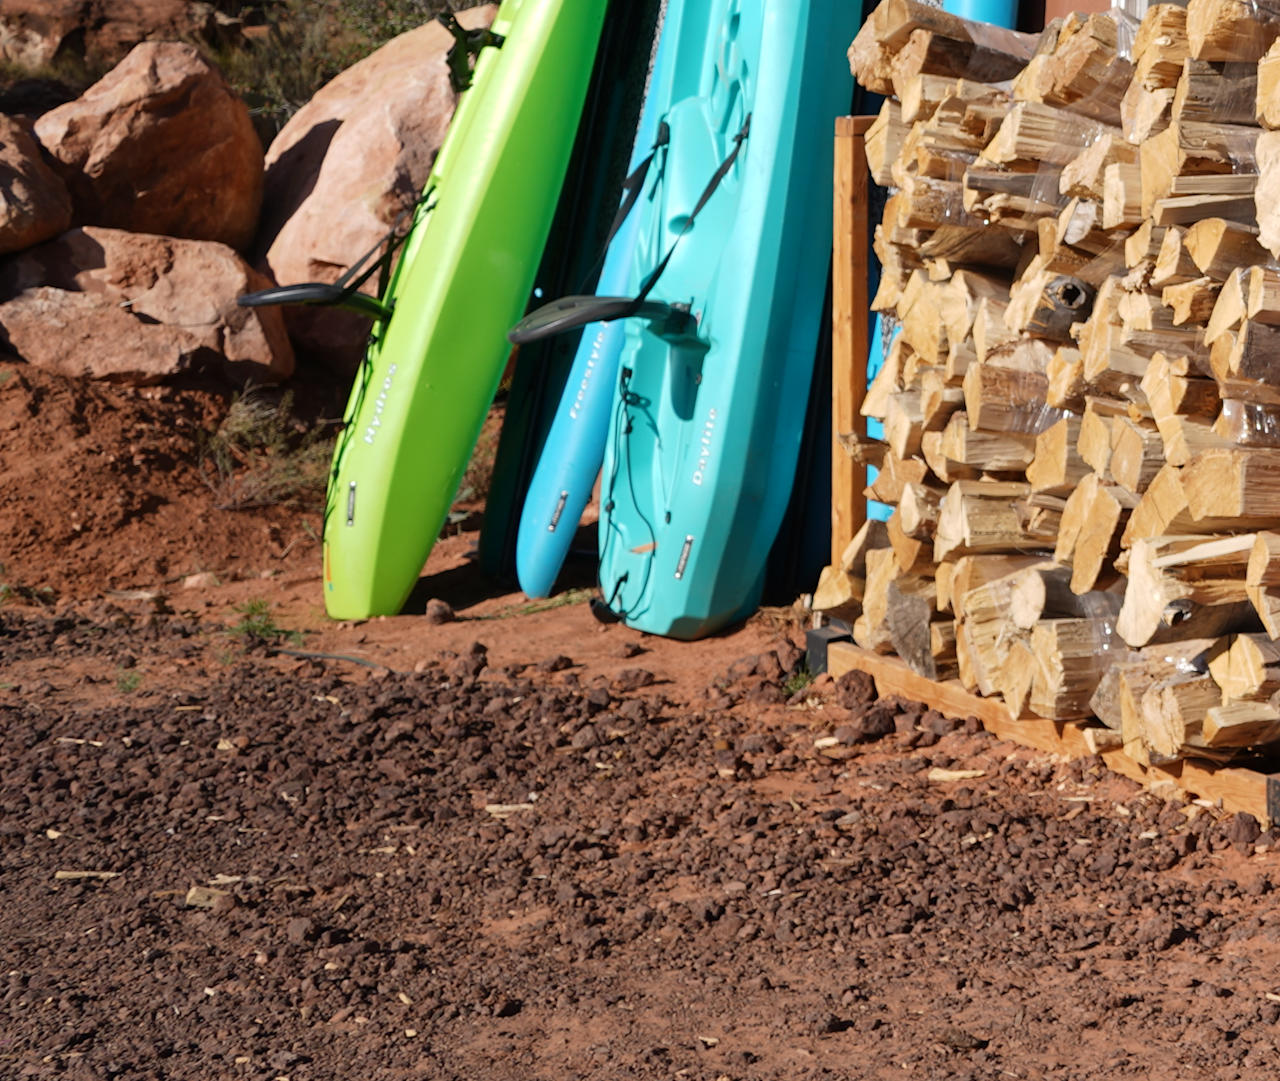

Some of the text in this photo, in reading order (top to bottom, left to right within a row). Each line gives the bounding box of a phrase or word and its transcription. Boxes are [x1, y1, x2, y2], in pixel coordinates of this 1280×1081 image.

[363, 363, 397, 446] Hydros
[569, 331, 605, 420] Freestyle
[692, 408, 718, 487] Daylite
